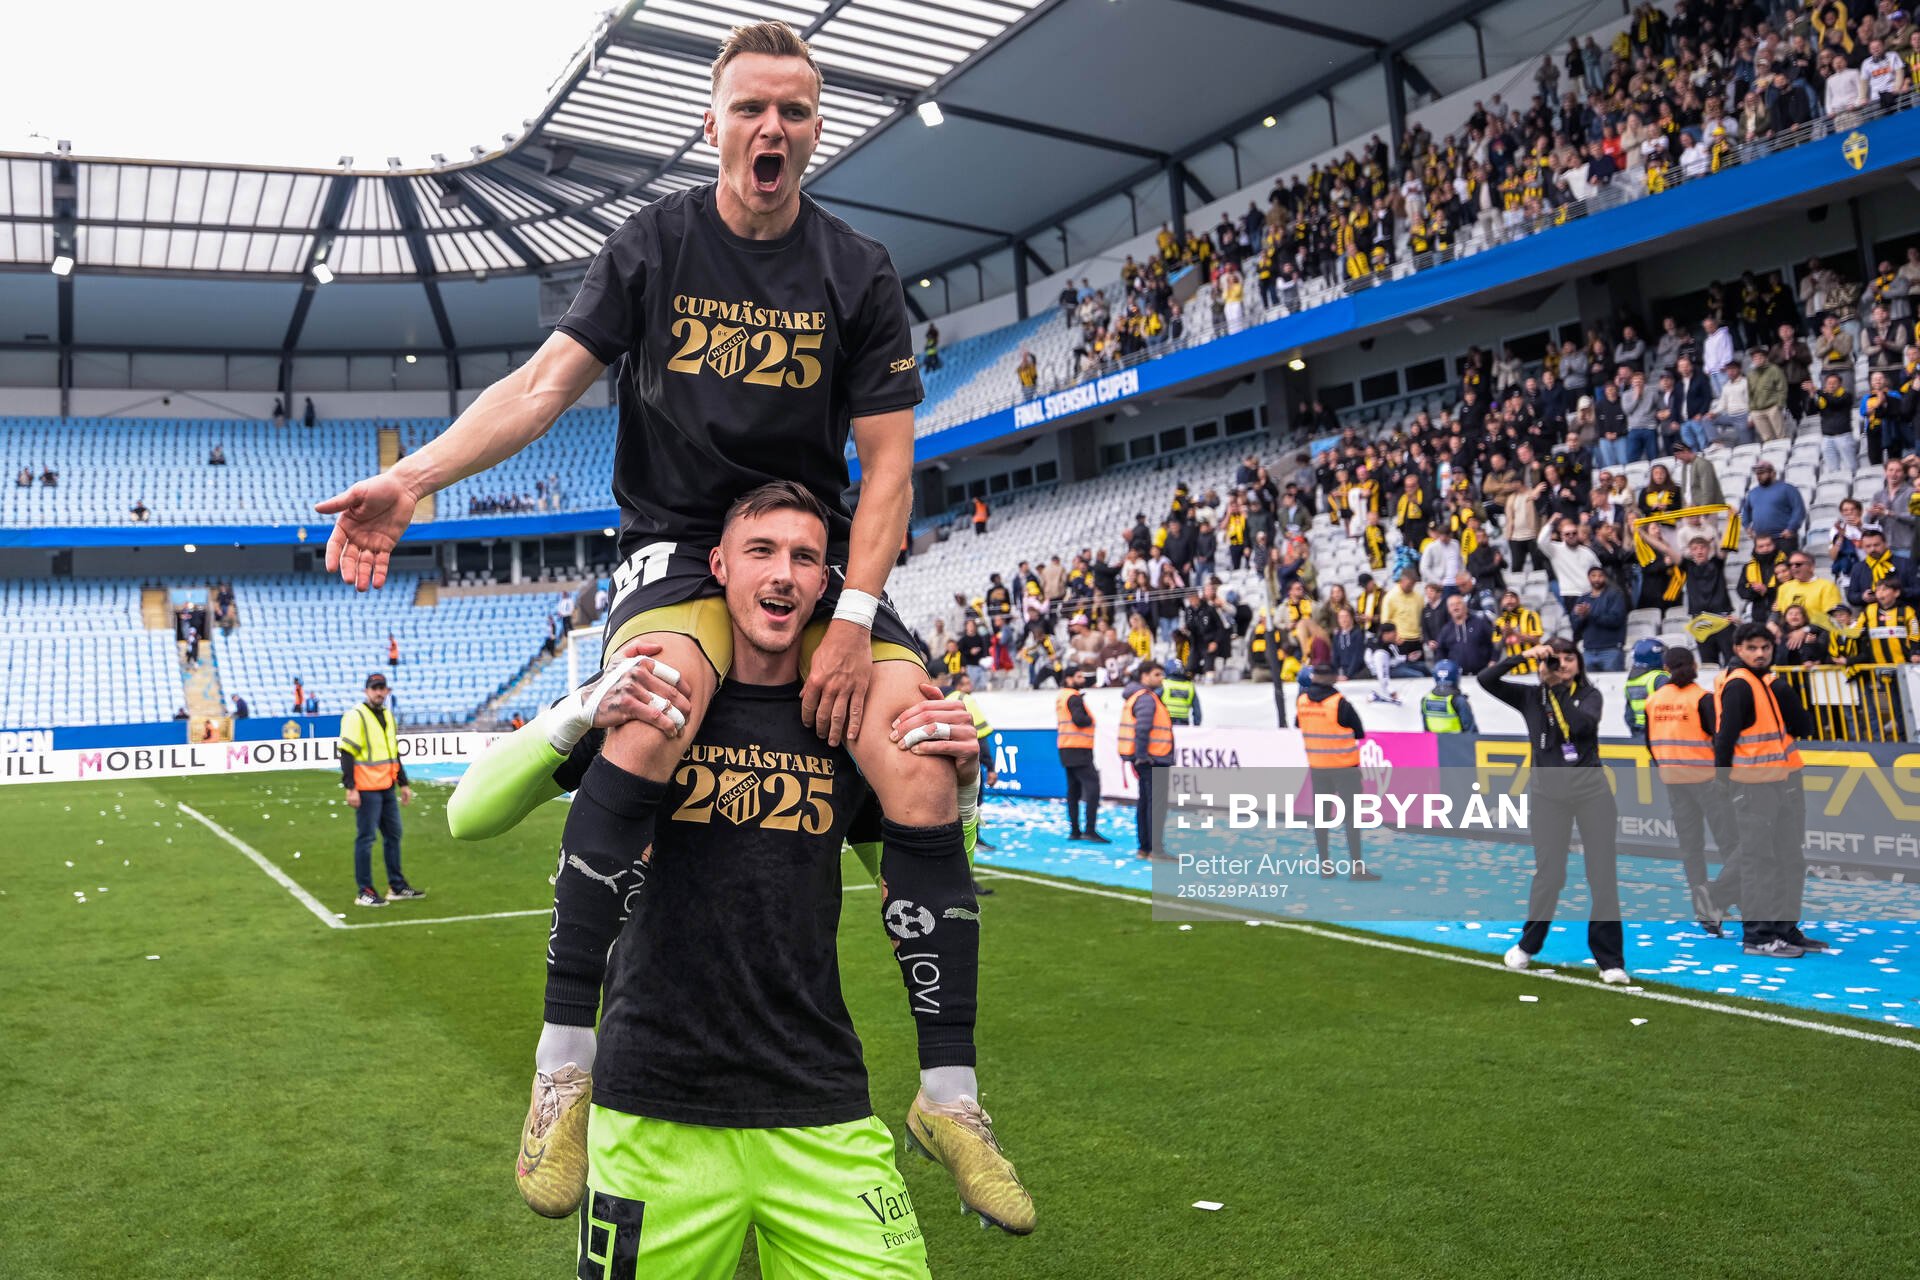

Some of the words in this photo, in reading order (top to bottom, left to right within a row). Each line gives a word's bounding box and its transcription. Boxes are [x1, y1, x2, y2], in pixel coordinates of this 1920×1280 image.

[673, 294, 826, 331] CUPMÄSTARE
[711, 333, 744, 358] HÄCKEN
[1014, 400, 1045, 429] FINAL
[1044, 382, 1097, 419] SVENSKA
[1097, 368, 1139, 402] CUPEN
[78, 748, 206, 777] MOBILL
[721, 777, 756, 805] HÄCKEN
[1801, 830, 1865, 854] ART
[1873, 833, 1920, 859] FÄ
